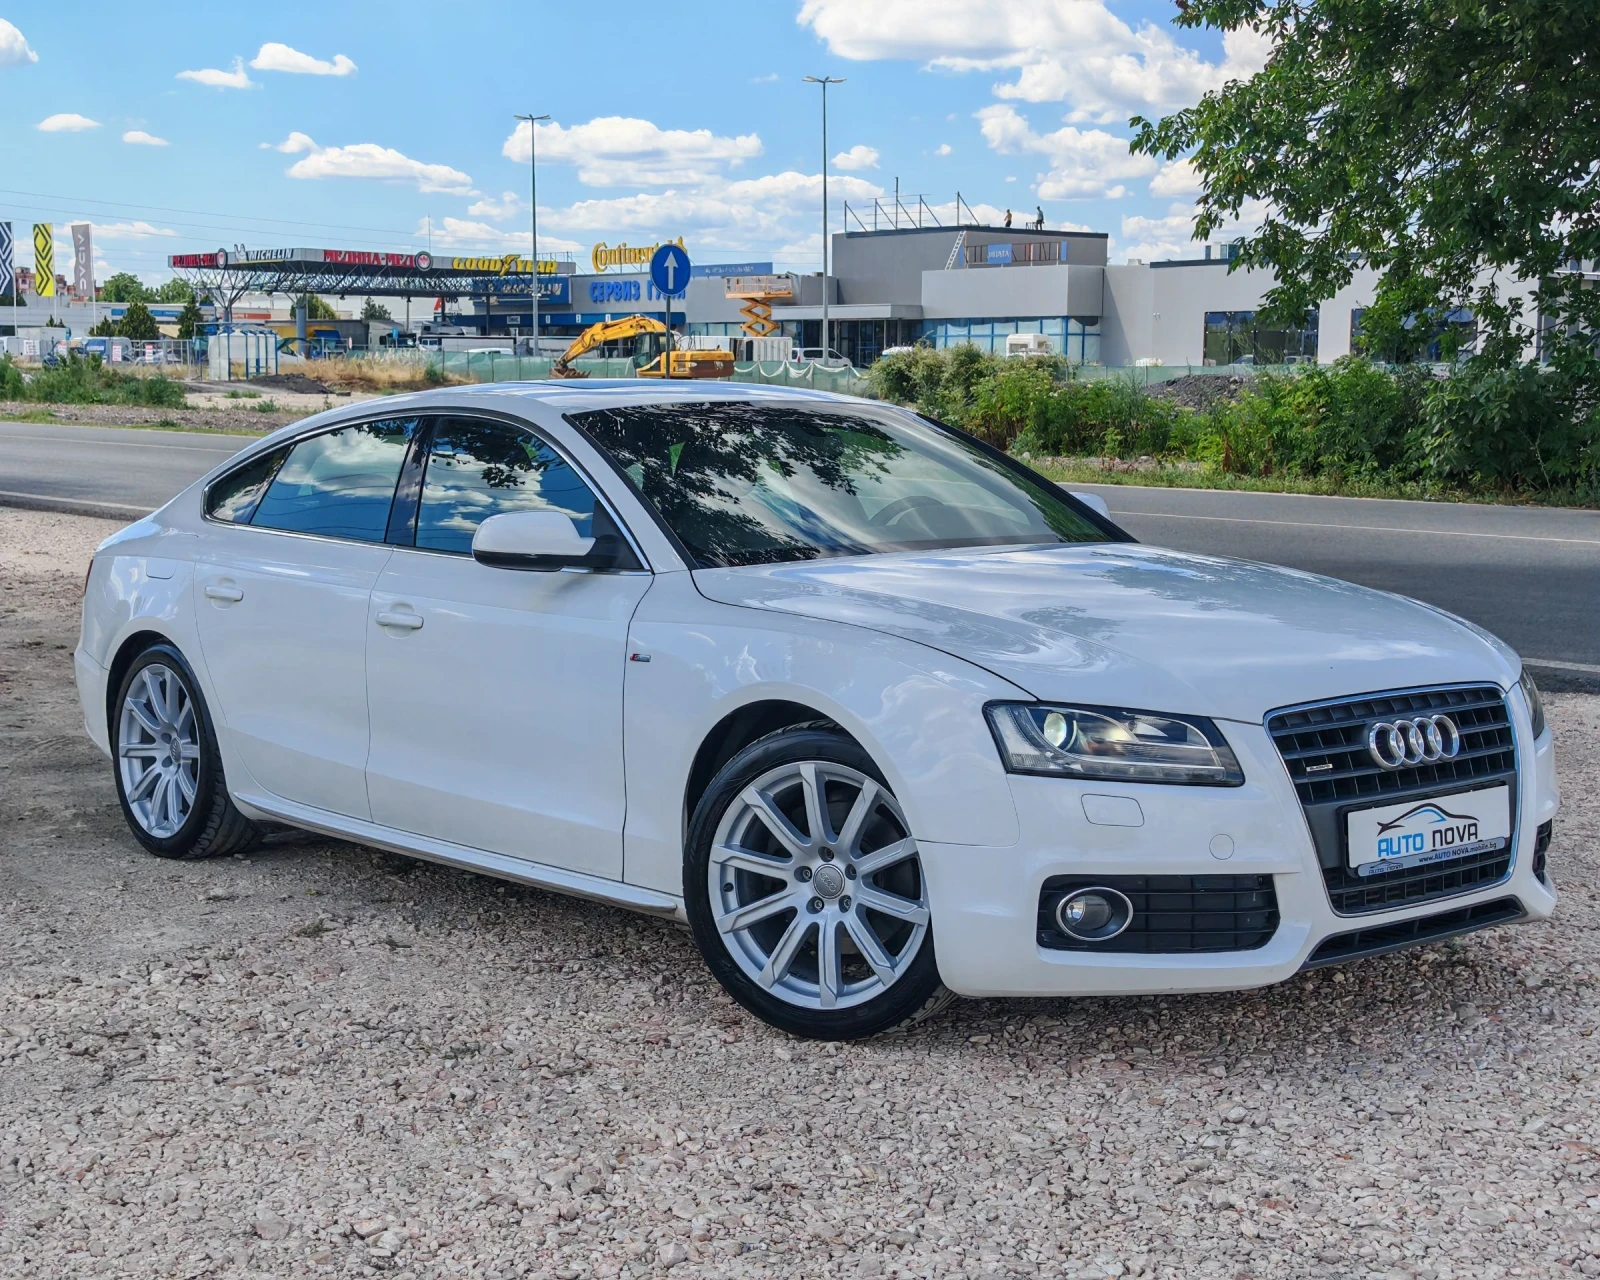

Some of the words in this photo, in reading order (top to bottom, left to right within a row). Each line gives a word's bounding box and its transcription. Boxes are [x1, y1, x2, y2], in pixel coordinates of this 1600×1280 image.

[248, 248, 294, 261] MICHELIN
[592, 240, 673, 272] Continen
[589, 281, 641, 303] СЕРВИЗ
[1377, 832, 1424, 858] AUTO
[1432, 822, 1478, 848] NOVA
